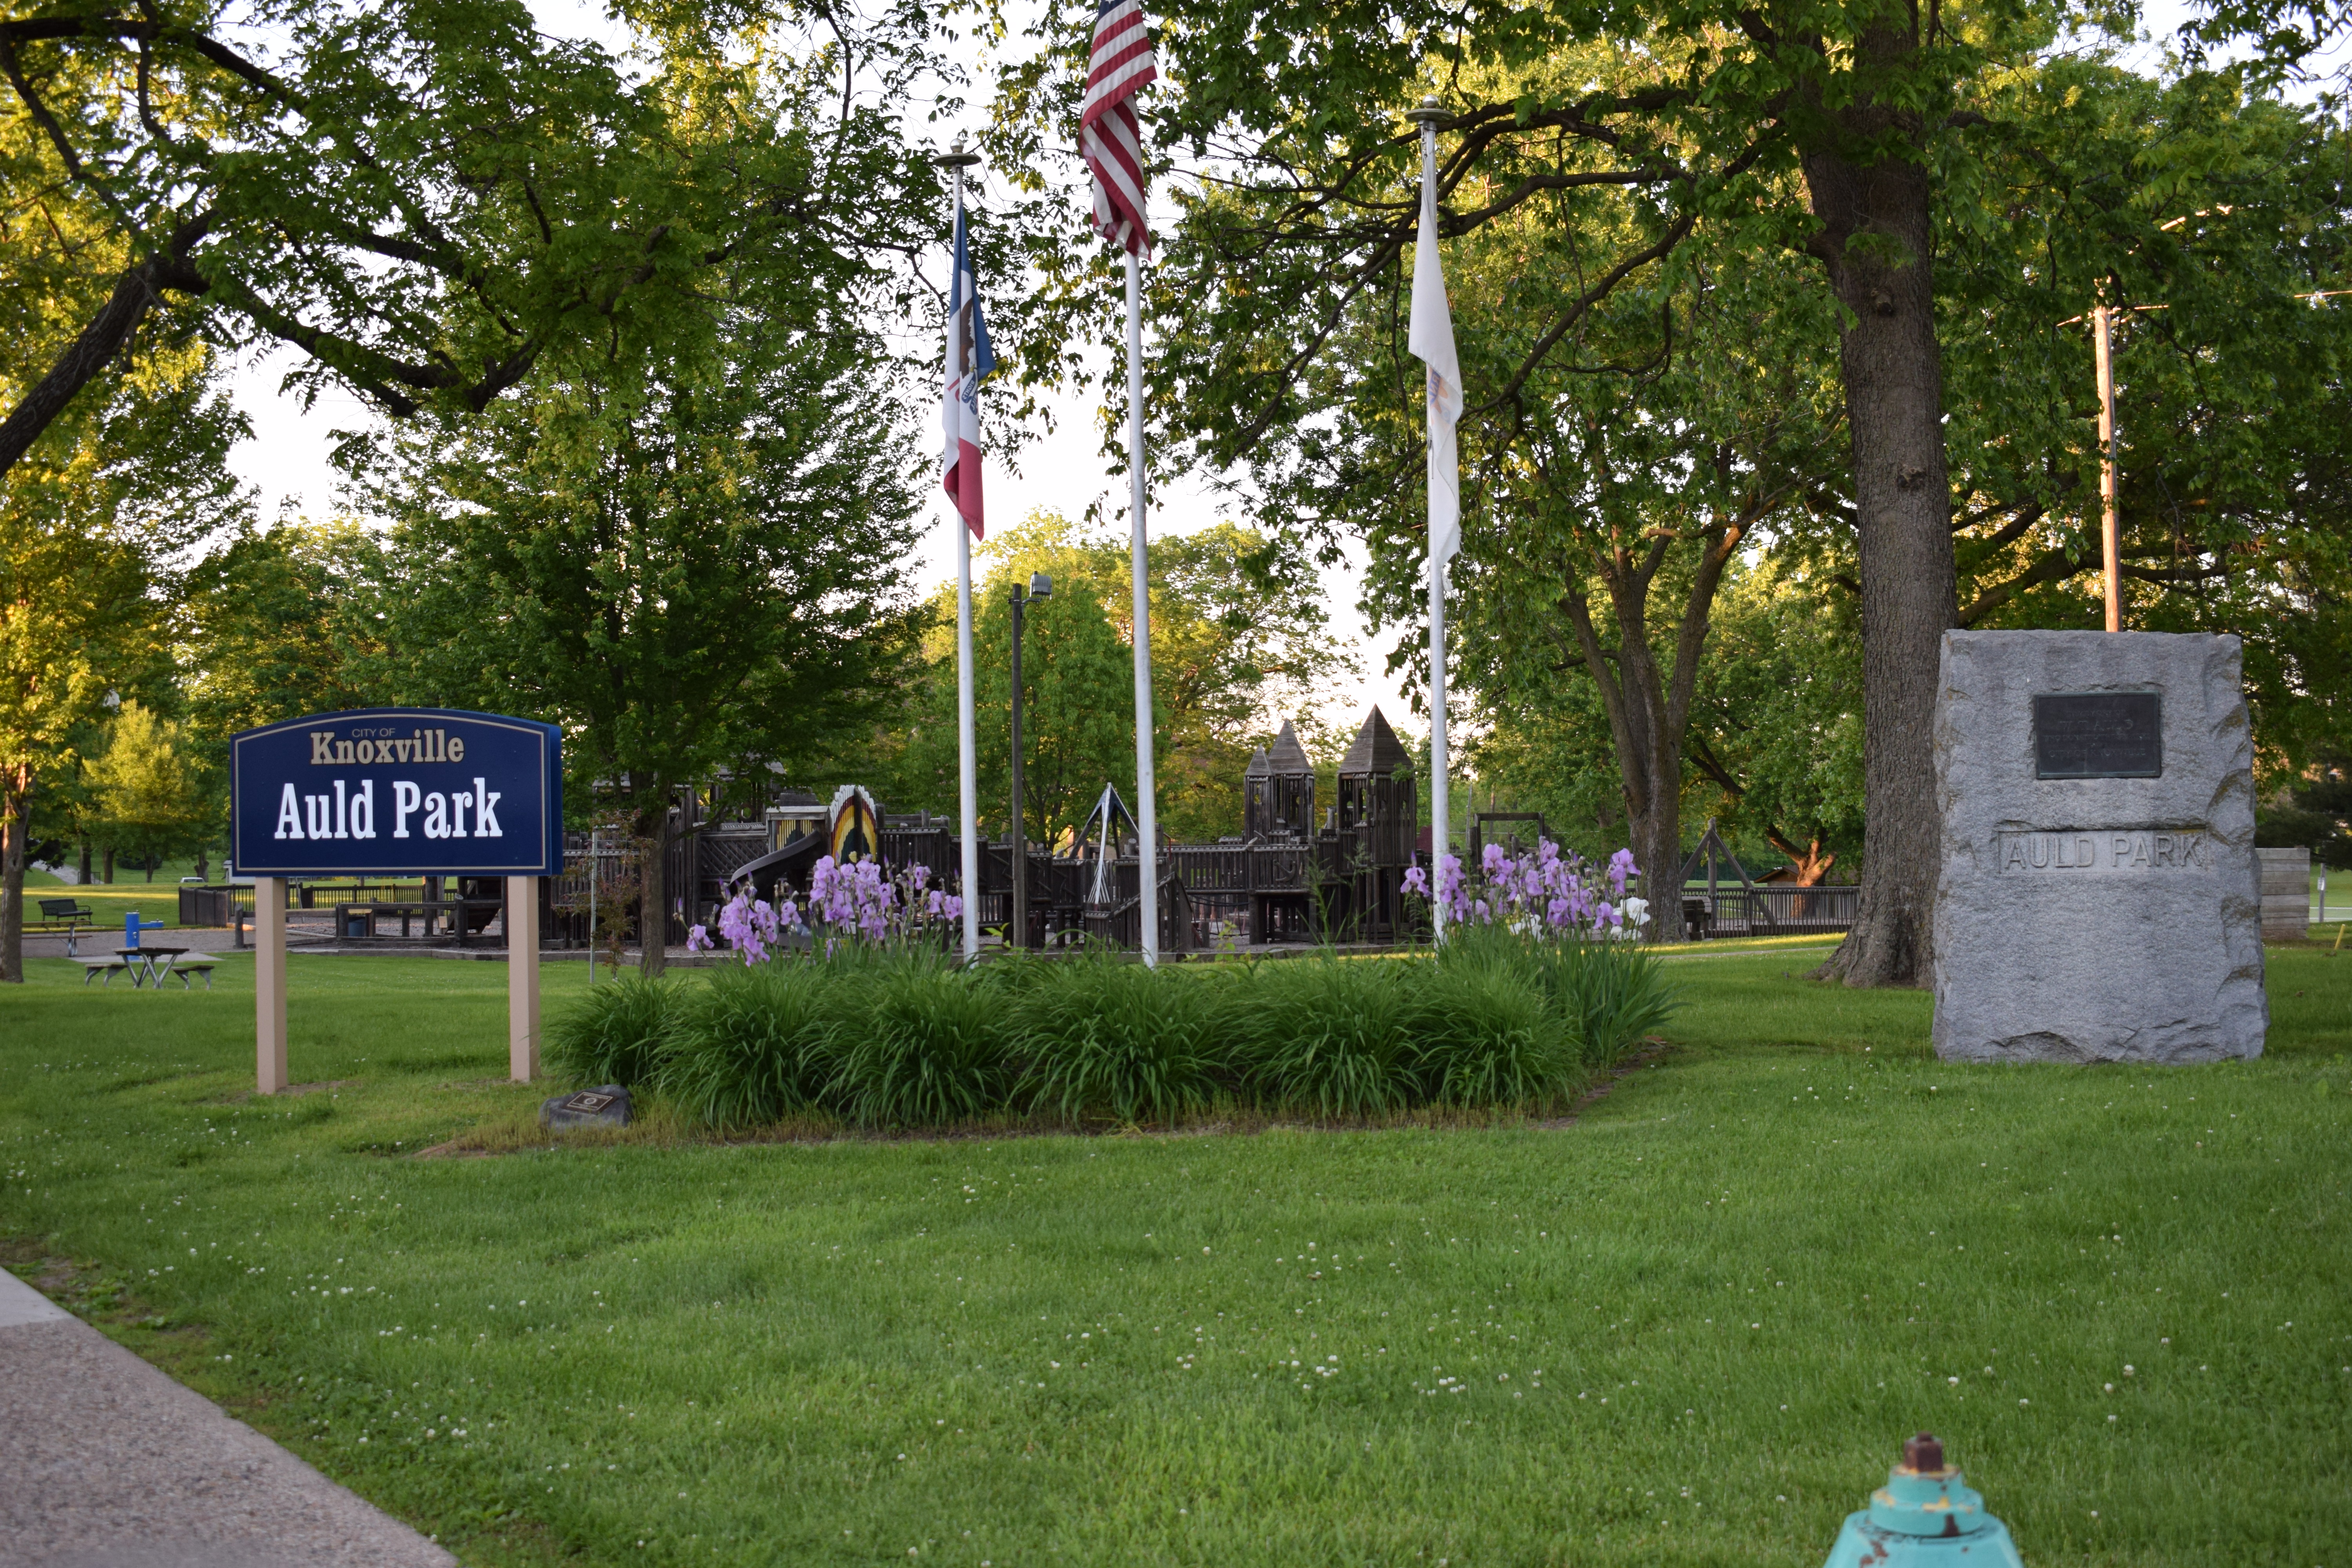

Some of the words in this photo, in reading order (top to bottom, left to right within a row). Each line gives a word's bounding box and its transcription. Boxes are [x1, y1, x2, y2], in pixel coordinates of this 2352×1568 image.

[310, 729, 465, 765] Knoxville
[352, 729, 376, 737] CITY
[379, 728, 396, 737] OF
[274, 780, 376, 839] Auld
[393, 778, 503, 838] Park
[2004, 837, 2094, 869] AULD
[2111, 835, 2202, 867] PARK
